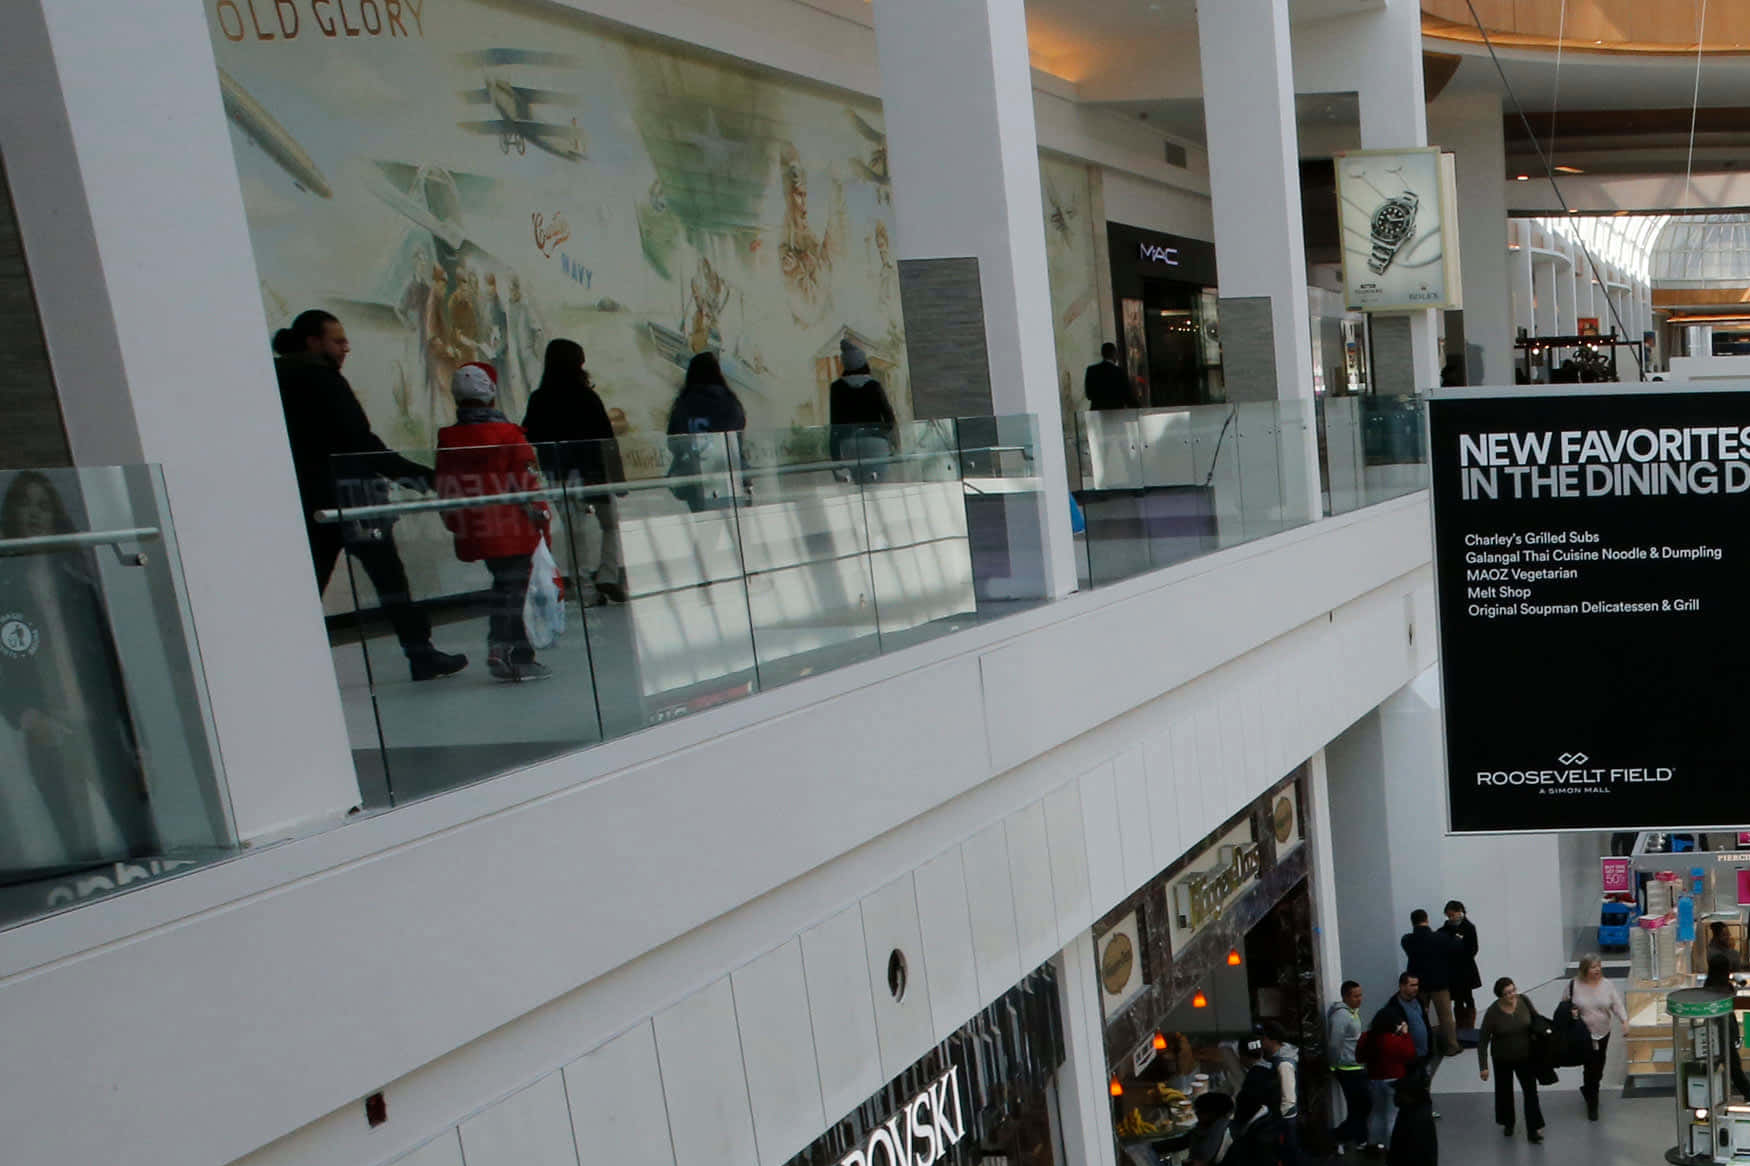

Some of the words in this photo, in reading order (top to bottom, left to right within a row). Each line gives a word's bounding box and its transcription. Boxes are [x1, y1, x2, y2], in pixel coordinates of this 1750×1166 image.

[216, 0, 299, 41] OLD
[312, 0, 423, 37] GLORY
[1459, 431, 1552, 466] NEW
[1461, 466, 1498, 500] IN
[1504, 464, 1580, 498] THE
[1586, 461, 1718, 496] DINING
[1525, 531, 1566, 545] Grilled
[1569, 531, 1600, 543] Subs
[1466, 550, 1520, 565] Galangal
[1522, 548, 1550, 562] Thai
[1552, 548, 1599, 561] Cuisine
[1602, 547, 1647, 560] Noodle
[1649, 546, 1660, 559] &
[1662, 545, 1722, 561] Dumpling
[1467, 568, 1509, 581] MAOZ
[1511, 567, 1578, 582] Vegetarian
[1467, 586, 1497, 599] Melt
[1499, 586, 1532, 600] Shop
[1468, 603, 1518, 618] Original
[1520, 603, 1578, 616] Soupman
[1581, 600, 1659, 613] Delicatessen
[1661, 599, 1672, 611] &
[1673, 598, 1700, 611] Grill
[1476, 769, 1606, 785] ROOSEVELT
[1610, 767, 1673, 783] FIELD
